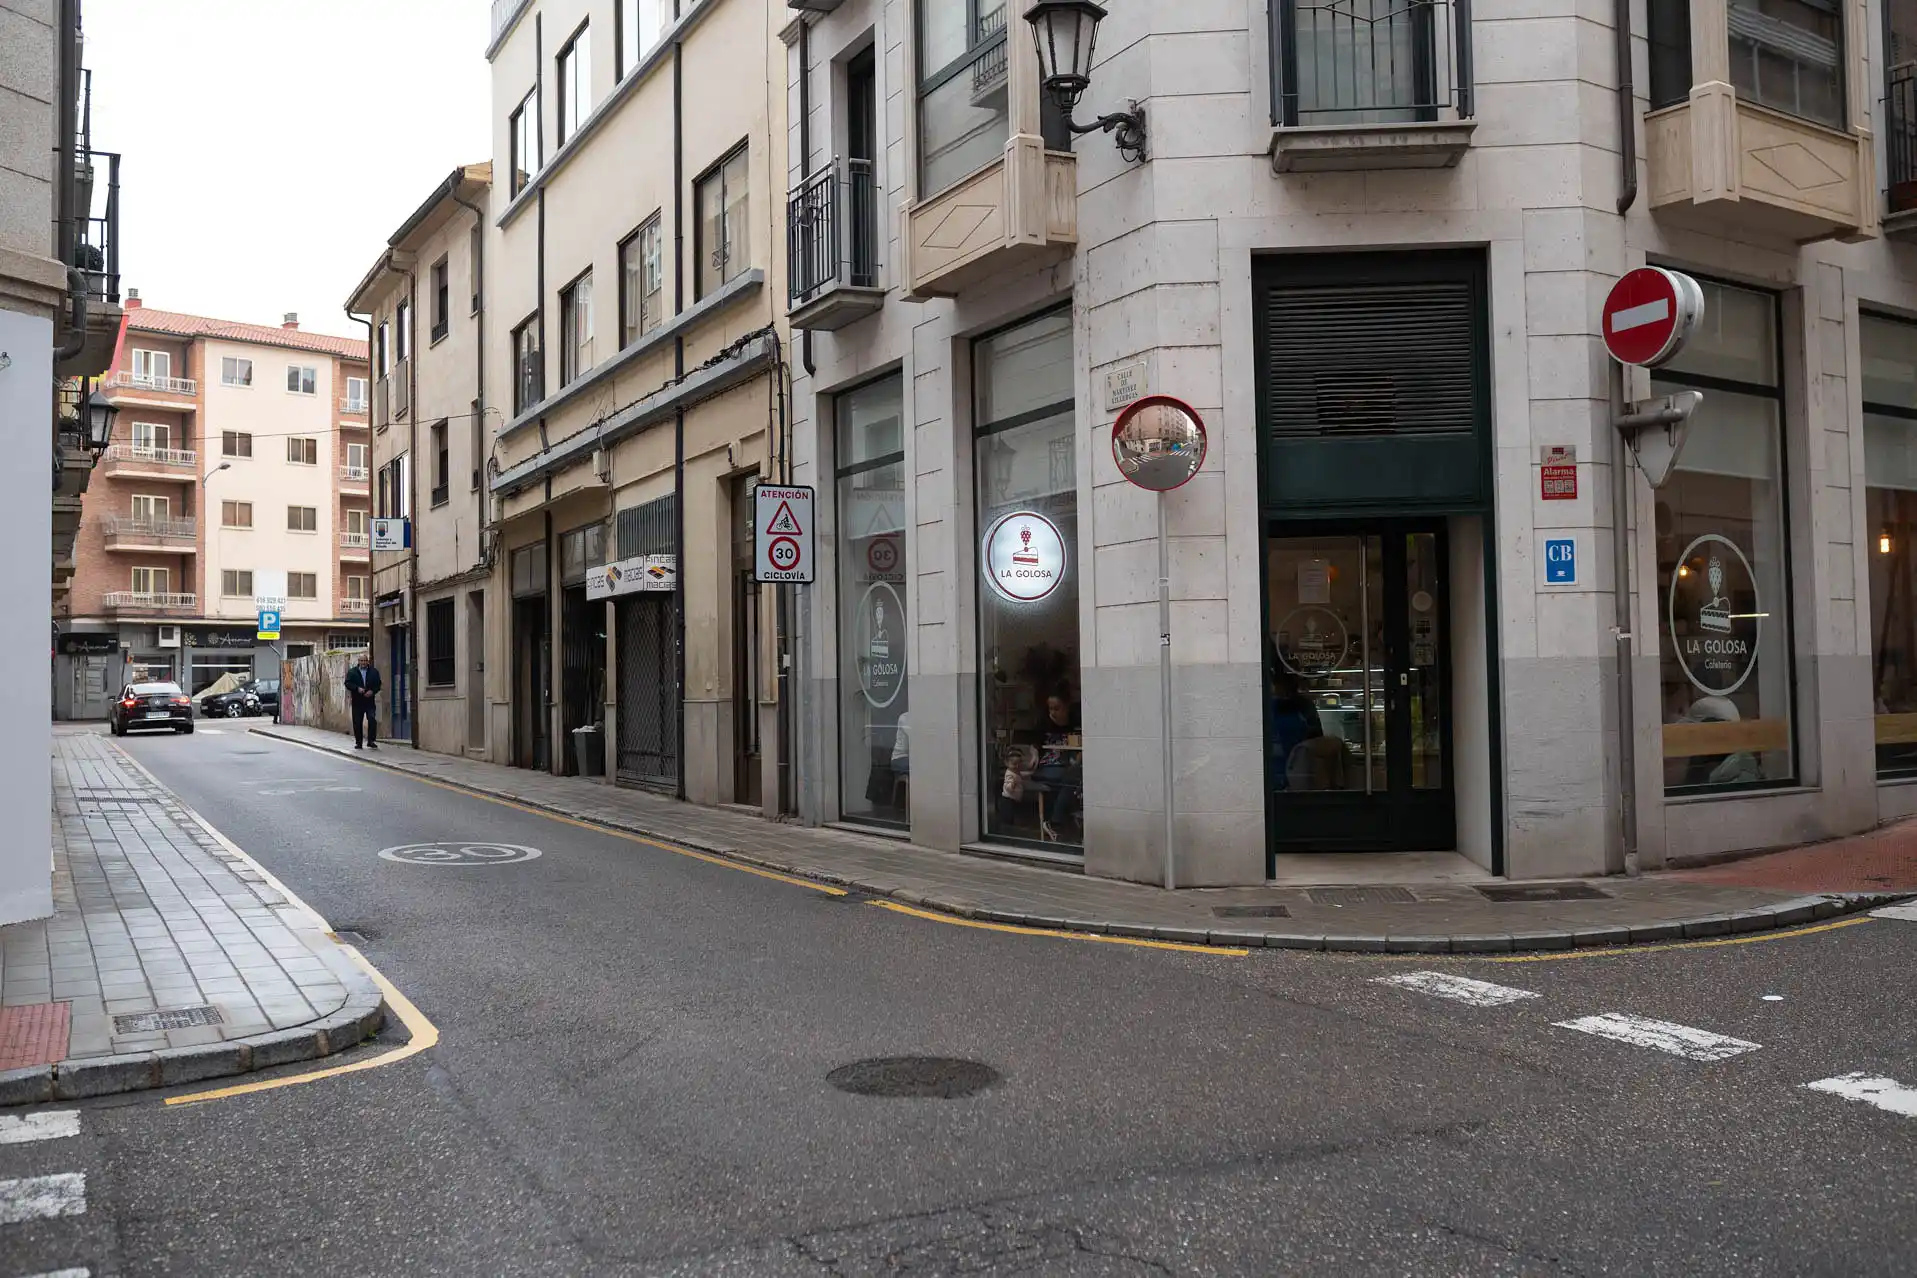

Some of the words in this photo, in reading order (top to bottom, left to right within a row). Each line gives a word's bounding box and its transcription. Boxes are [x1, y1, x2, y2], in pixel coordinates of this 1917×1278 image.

[1117, 370, 1132, 380] CALLE
[761, 489, 808, 499] ATENCIÓN
[776, 548, 793, 559] 30
[1549, 545, 1572, 562] CB
[764, 571, 805, 580] CICLOVÍA
[1001, 570, 1012, 578] LA
[1015, 570, 1052, 578] GOLOSA
[263, 613, 276, 629] P
[1687, 640, 1700, 654] LA
[1704, 640, 1747, 654] GOLOSA
[873, 663, 898, 675] GOLOSA
[404, 847, 516, 861] 30
